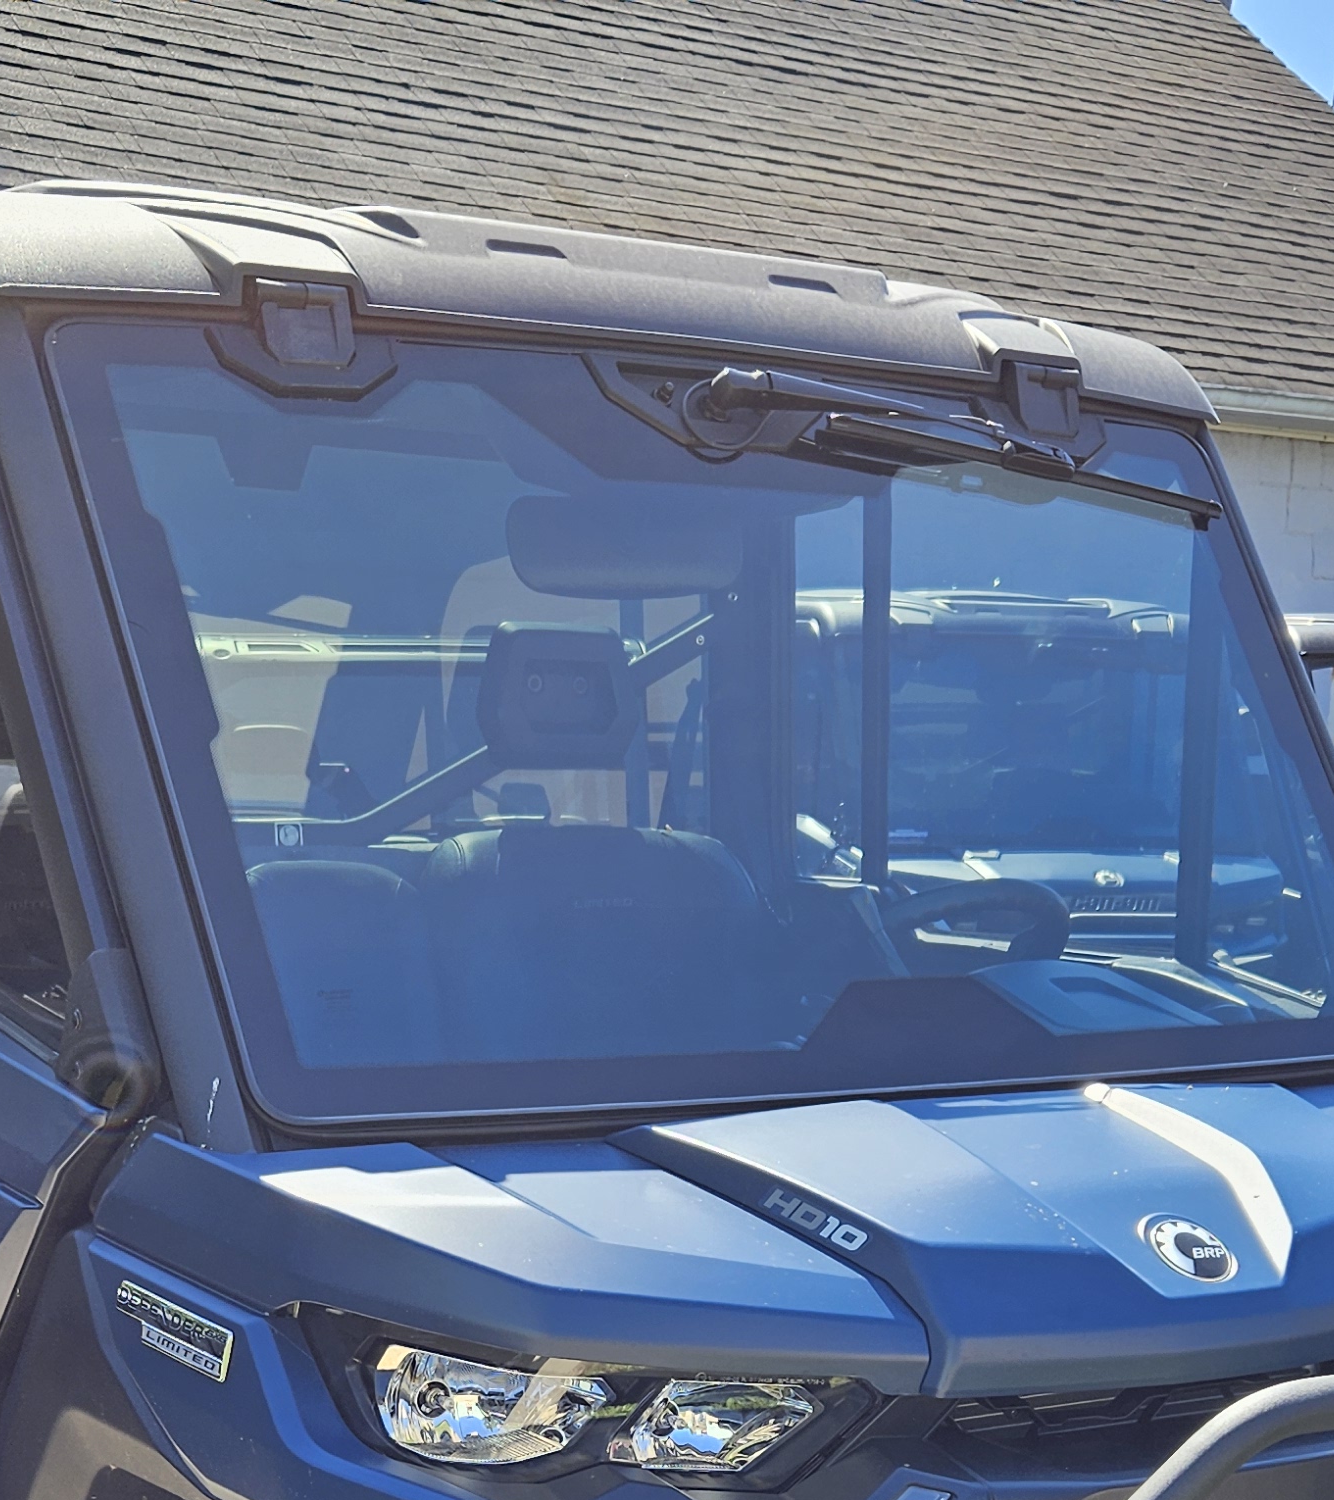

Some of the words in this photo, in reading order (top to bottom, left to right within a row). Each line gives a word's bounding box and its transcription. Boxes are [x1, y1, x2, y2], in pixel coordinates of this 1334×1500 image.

[763, 1188, 868, 1251] HD10
[1192, 1246, 1225, 1259] BRP
[116, 1284, 205, 1343] DEFENDER
[146, 1330, 216, 1371] LIMITED
